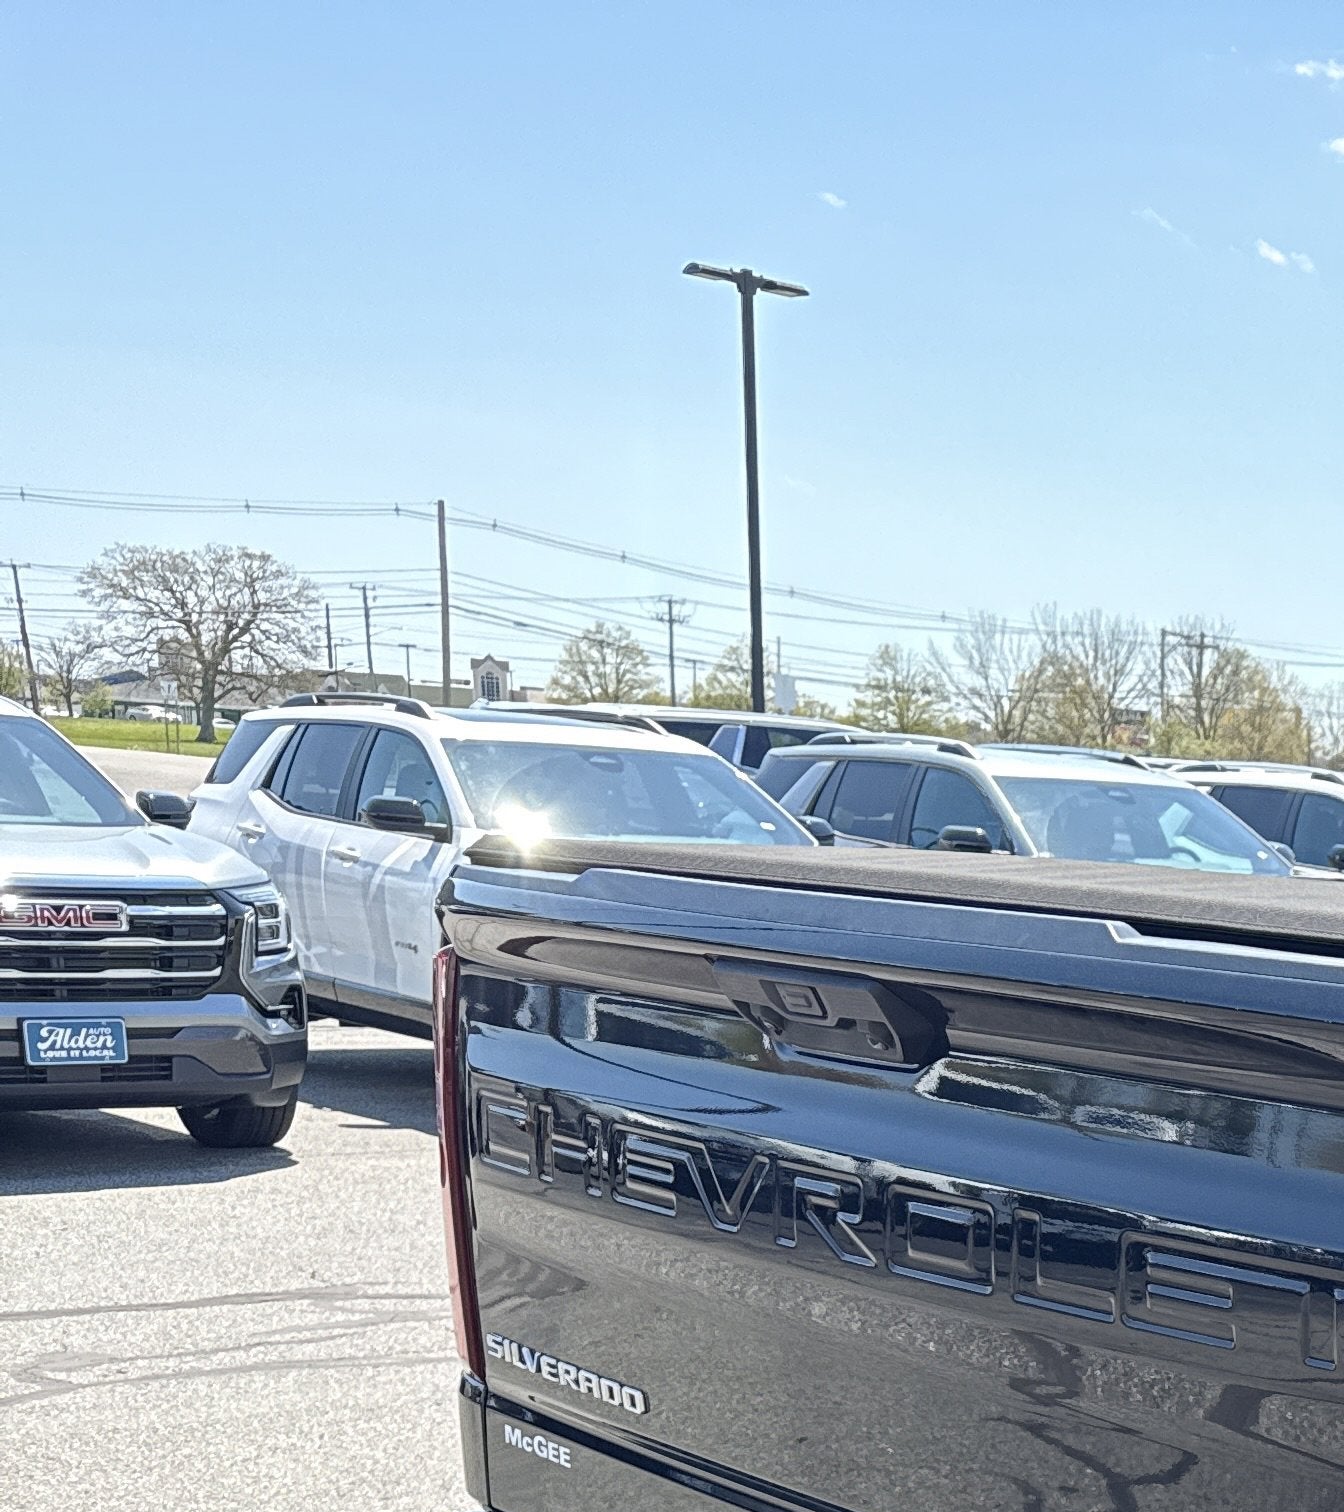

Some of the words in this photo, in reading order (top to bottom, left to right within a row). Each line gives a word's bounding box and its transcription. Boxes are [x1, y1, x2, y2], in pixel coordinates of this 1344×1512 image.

[0, 904, 122, 928] GMC
[36, 1026, 116, 1050] Alden
[88, 1027, 112, 1035] AUTO
[40, 1050, 67, 1058] LOVE
[82, 1049, 116, 1057] LOCAL
[485, 1332, 650, 1415] SILVERADO
[504, 1423, 572, 1469] McGEE
